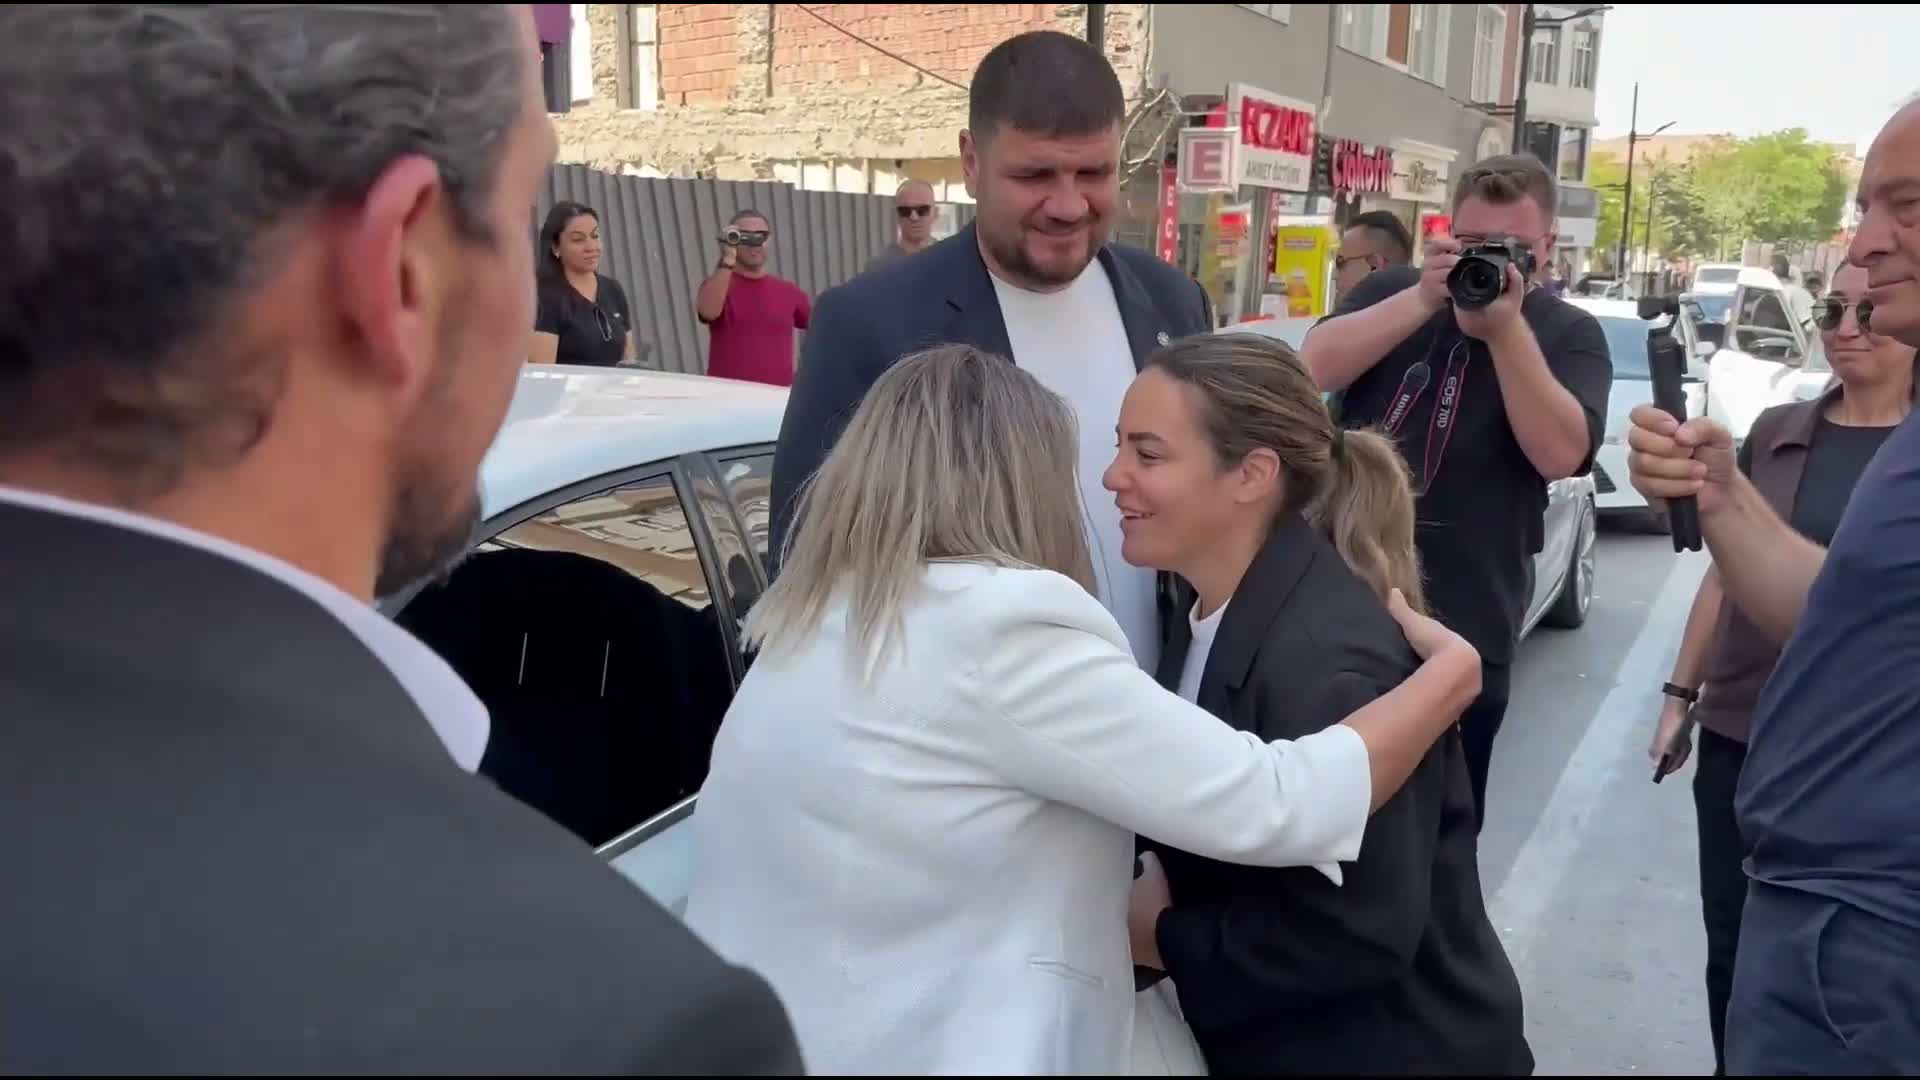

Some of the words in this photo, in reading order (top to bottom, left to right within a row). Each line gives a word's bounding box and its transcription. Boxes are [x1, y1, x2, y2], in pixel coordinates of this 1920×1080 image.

[1192, 141, 1222, 179] E
[1441, 376, 1457, 406] EOS
[1436, 407, 1451, 429] 70D
